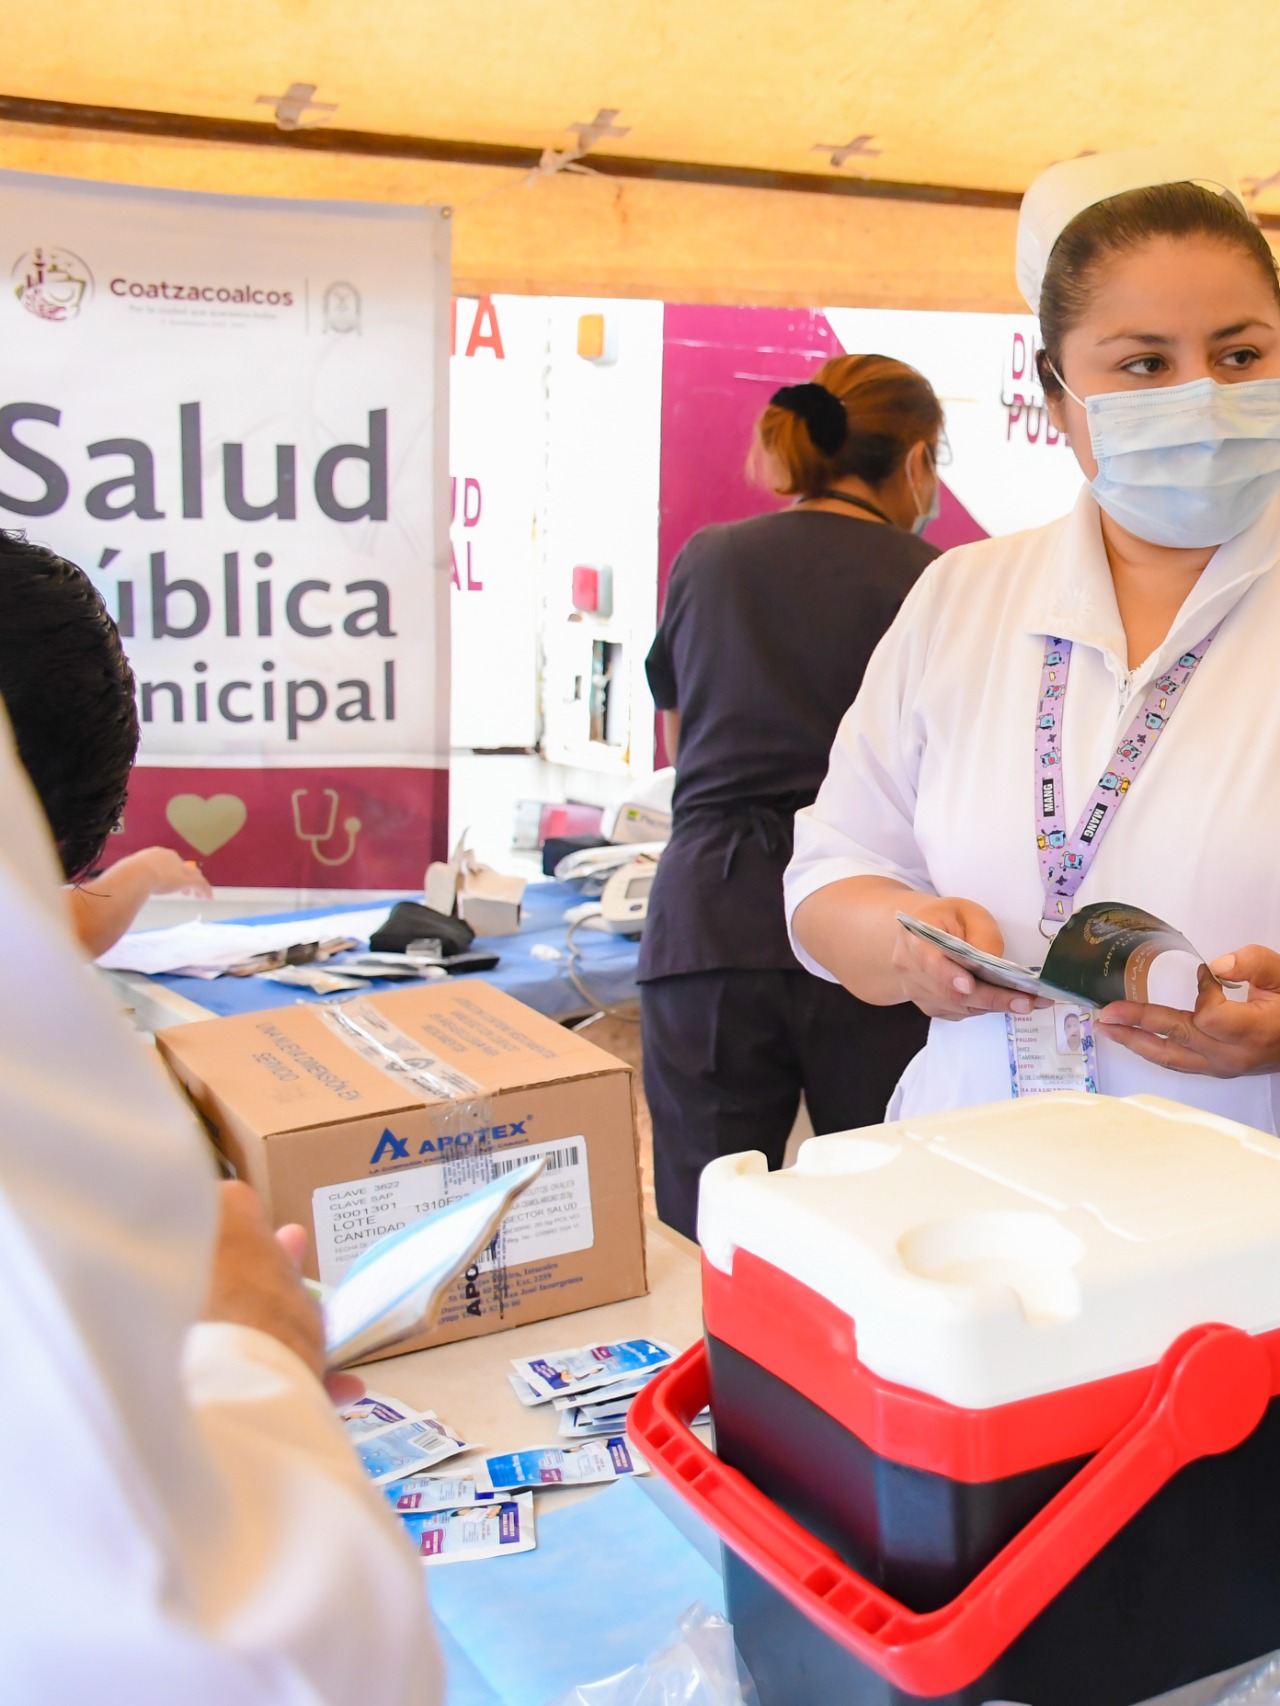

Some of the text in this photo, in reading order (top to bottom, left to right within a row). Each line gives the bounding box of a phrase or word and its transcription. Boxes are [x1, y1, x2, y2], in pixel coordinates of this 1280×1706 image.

[110, 278, 294, 307] Coatzacoalcos
[0, 401, 389, 522] Salud
[97, 548, 398, 639] ública
[140, 660, 396, 741] nicipal
[1046, 783, 1054, 813] MANG
[1083, 807, 1106, 839] MANG
[419, 1121, 527, 1155] APOTEX
[329, 1193, 394, 1211] CLAVE SAP
[333, 1203, 397, 1222] 3001301
[504, 1202, 578, 1223] SECTOR SALUD
[333, 1215, 376, 1232] LOTE
[334, 1222, 406, 1245] CANTIDAD
[465, 1263, 482, 1317] APO
